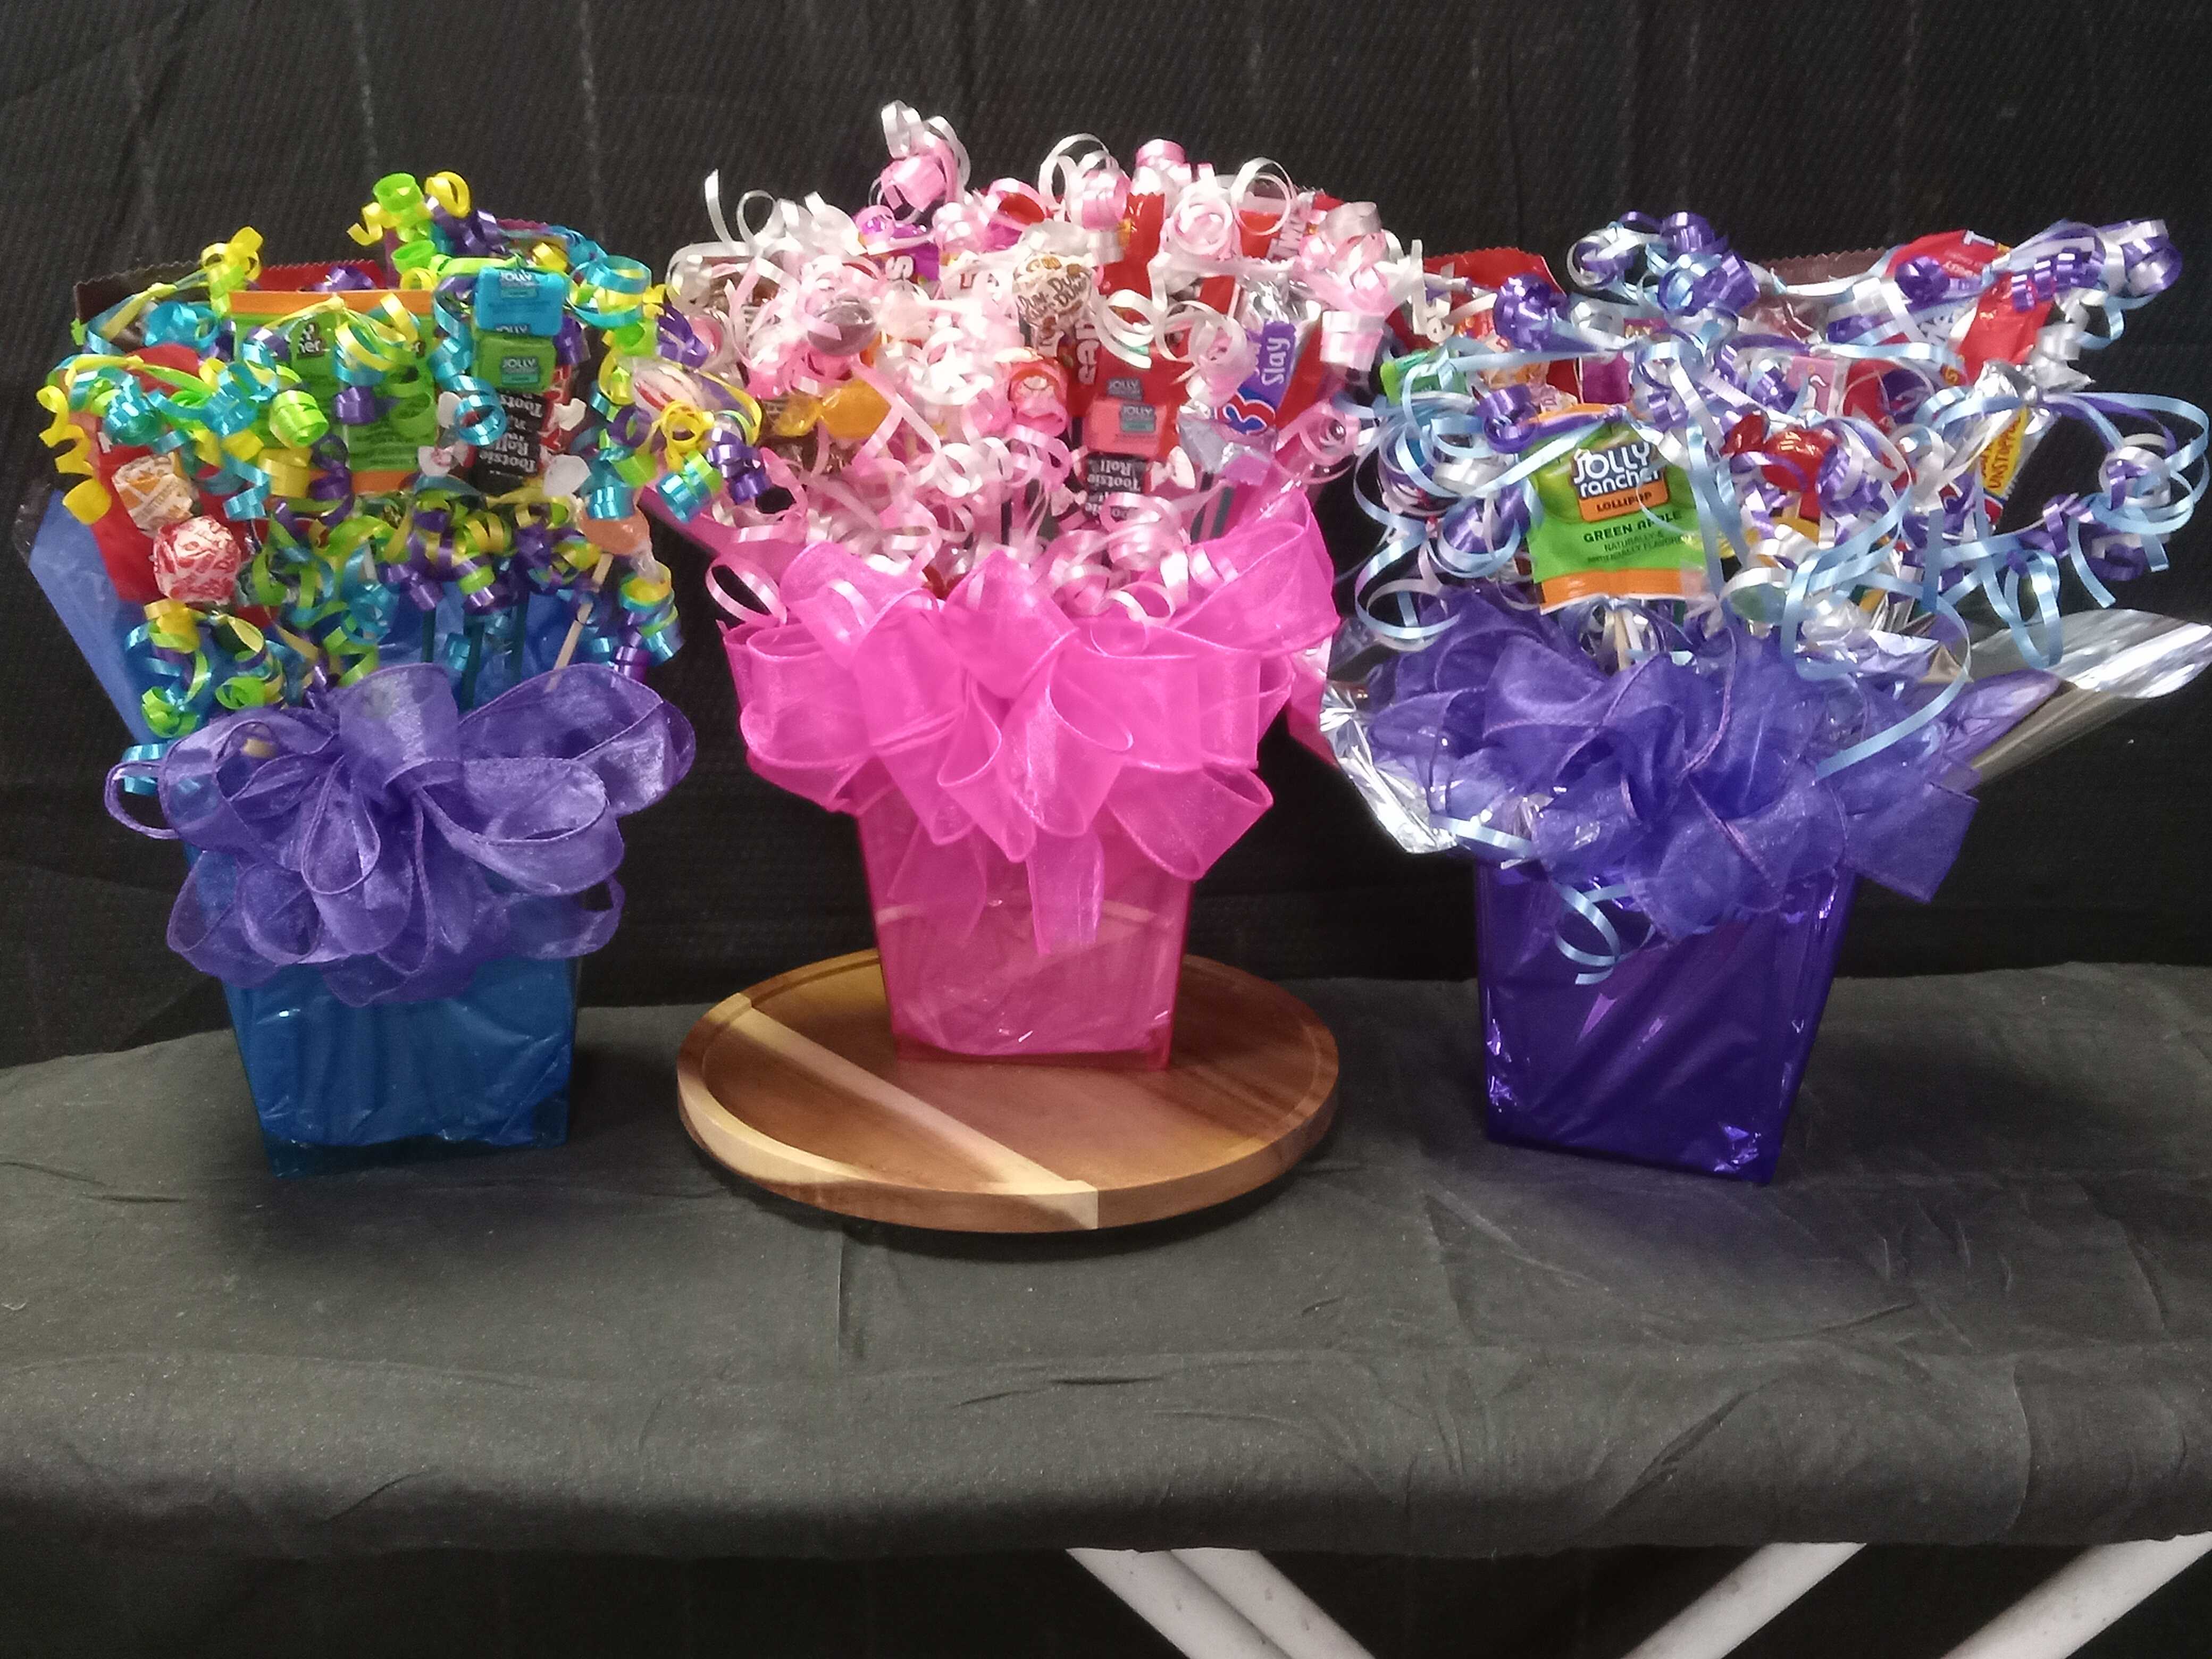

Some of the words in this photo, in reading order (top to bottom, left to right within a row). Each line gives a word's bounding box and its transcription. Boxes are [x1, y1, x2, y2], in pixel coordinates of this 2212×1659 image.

[501, 358, 536, 368] JOLLY
[1261, 337, 1291, 386] Slay
[1109, 380, 1136, 390] JOLLY
[1123, 406, 1153, 416] JOLLY
[479, 451, 537, 473] Tootsie
[1100, 459, 1132, 476] Roll
[1573, 441, 1650, 484] JOLLY
[1087, 474, 1141, 492] Tootsie
[1596, 491, 1653, 512] LOLLIPOP
[1583, 523, 1632, 542] GREEN
